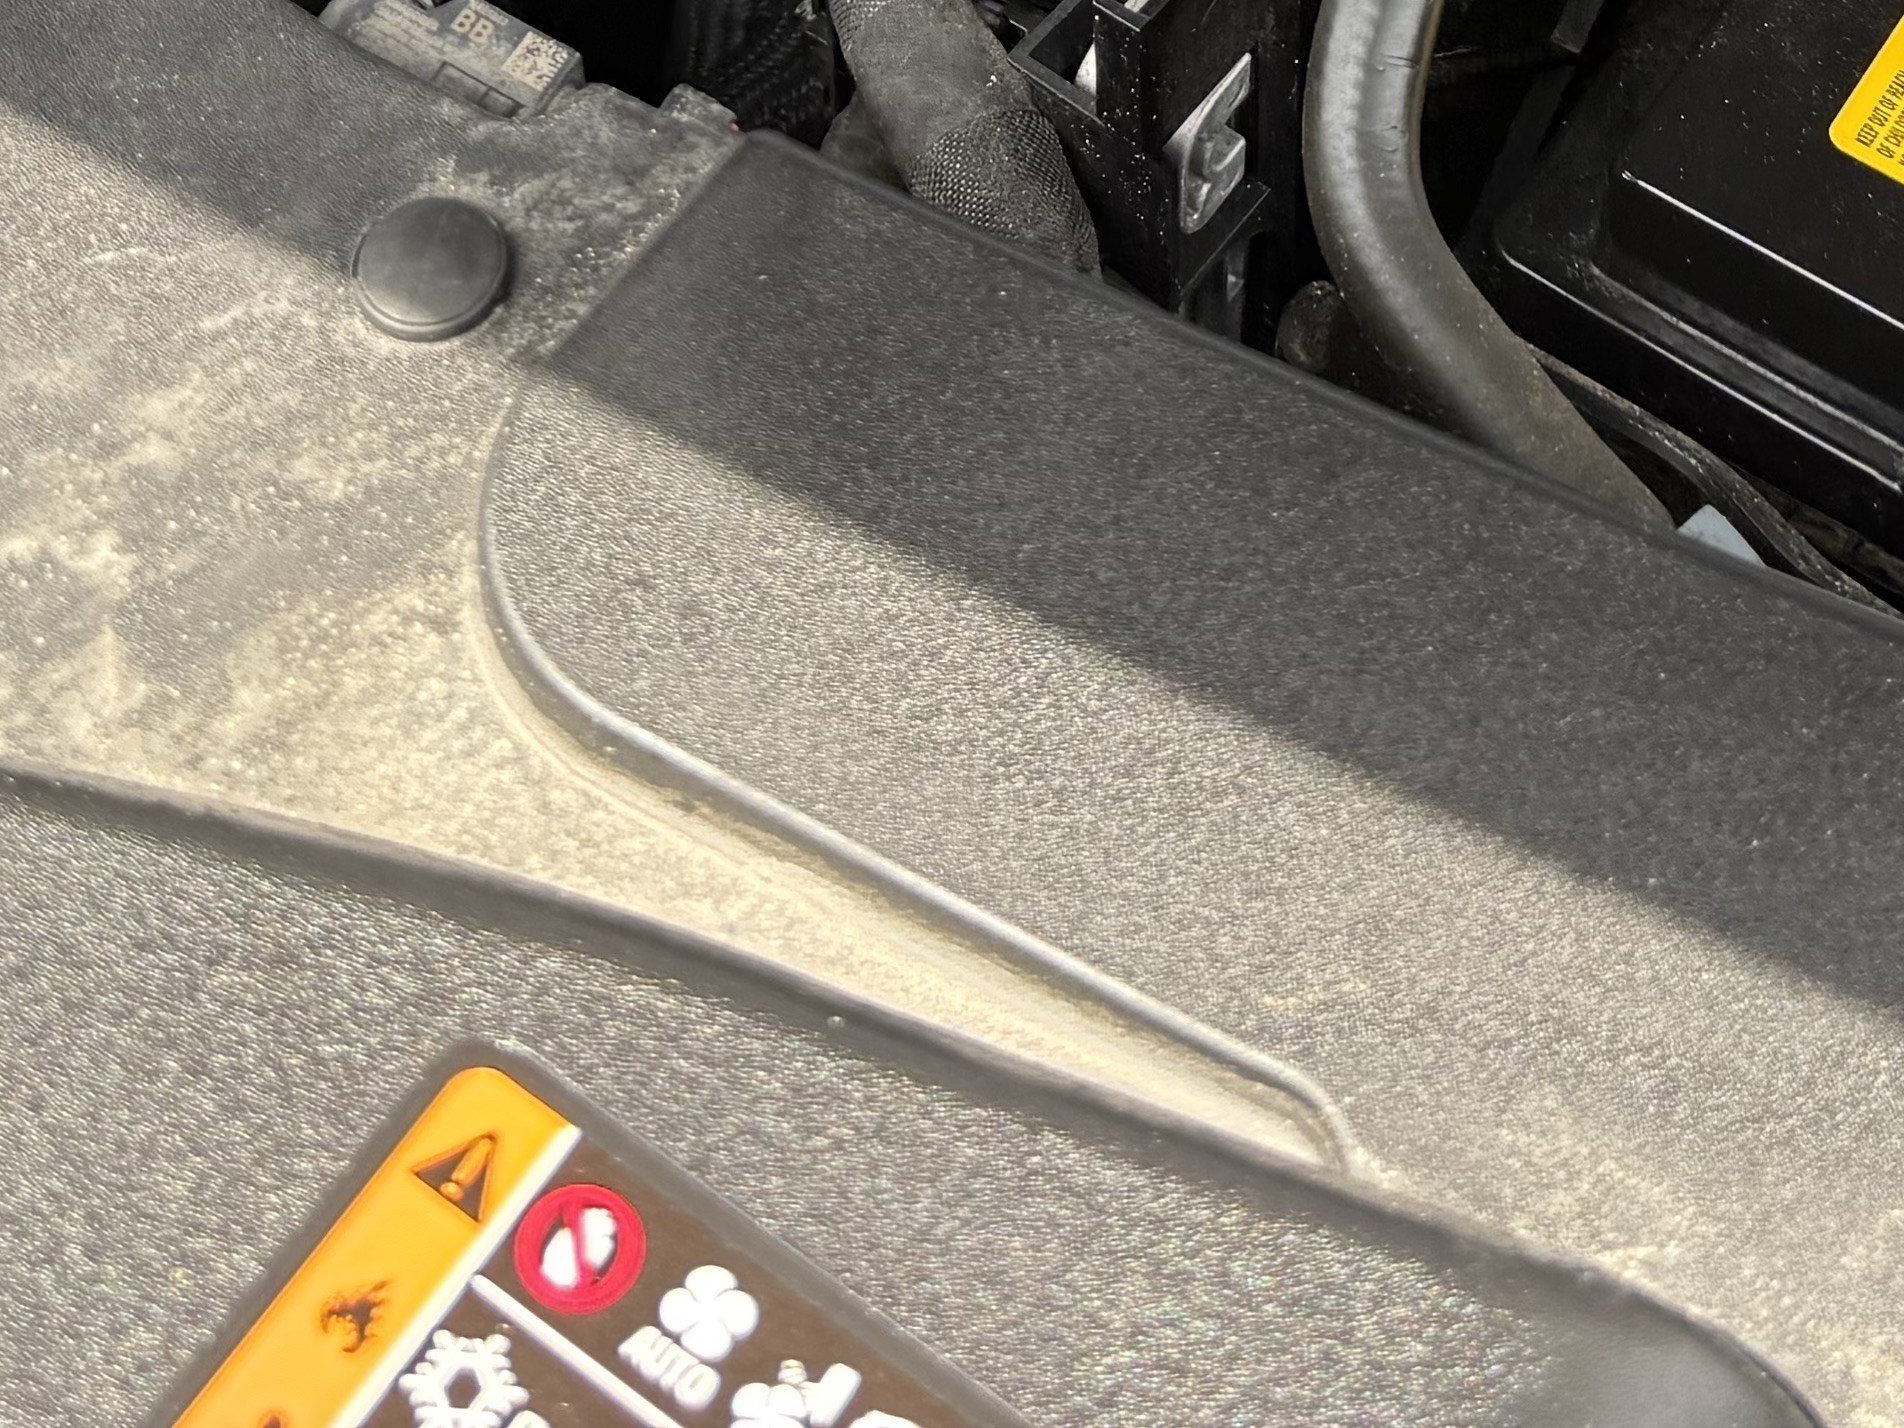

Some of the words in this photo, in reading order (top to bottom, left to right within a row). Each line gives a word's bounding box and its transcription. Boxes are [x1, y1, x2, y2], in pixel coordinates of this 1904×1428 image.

[451, 8, 496, 43] BB
[1877, 94, 1899, 111] OF
[1867, 106, 1891, 128] OUT
[1854, 122, 1881, 147] KEEP
[1875, 142, 1897, 159] OF
[617, 1324, 722, 1410] AUTO
